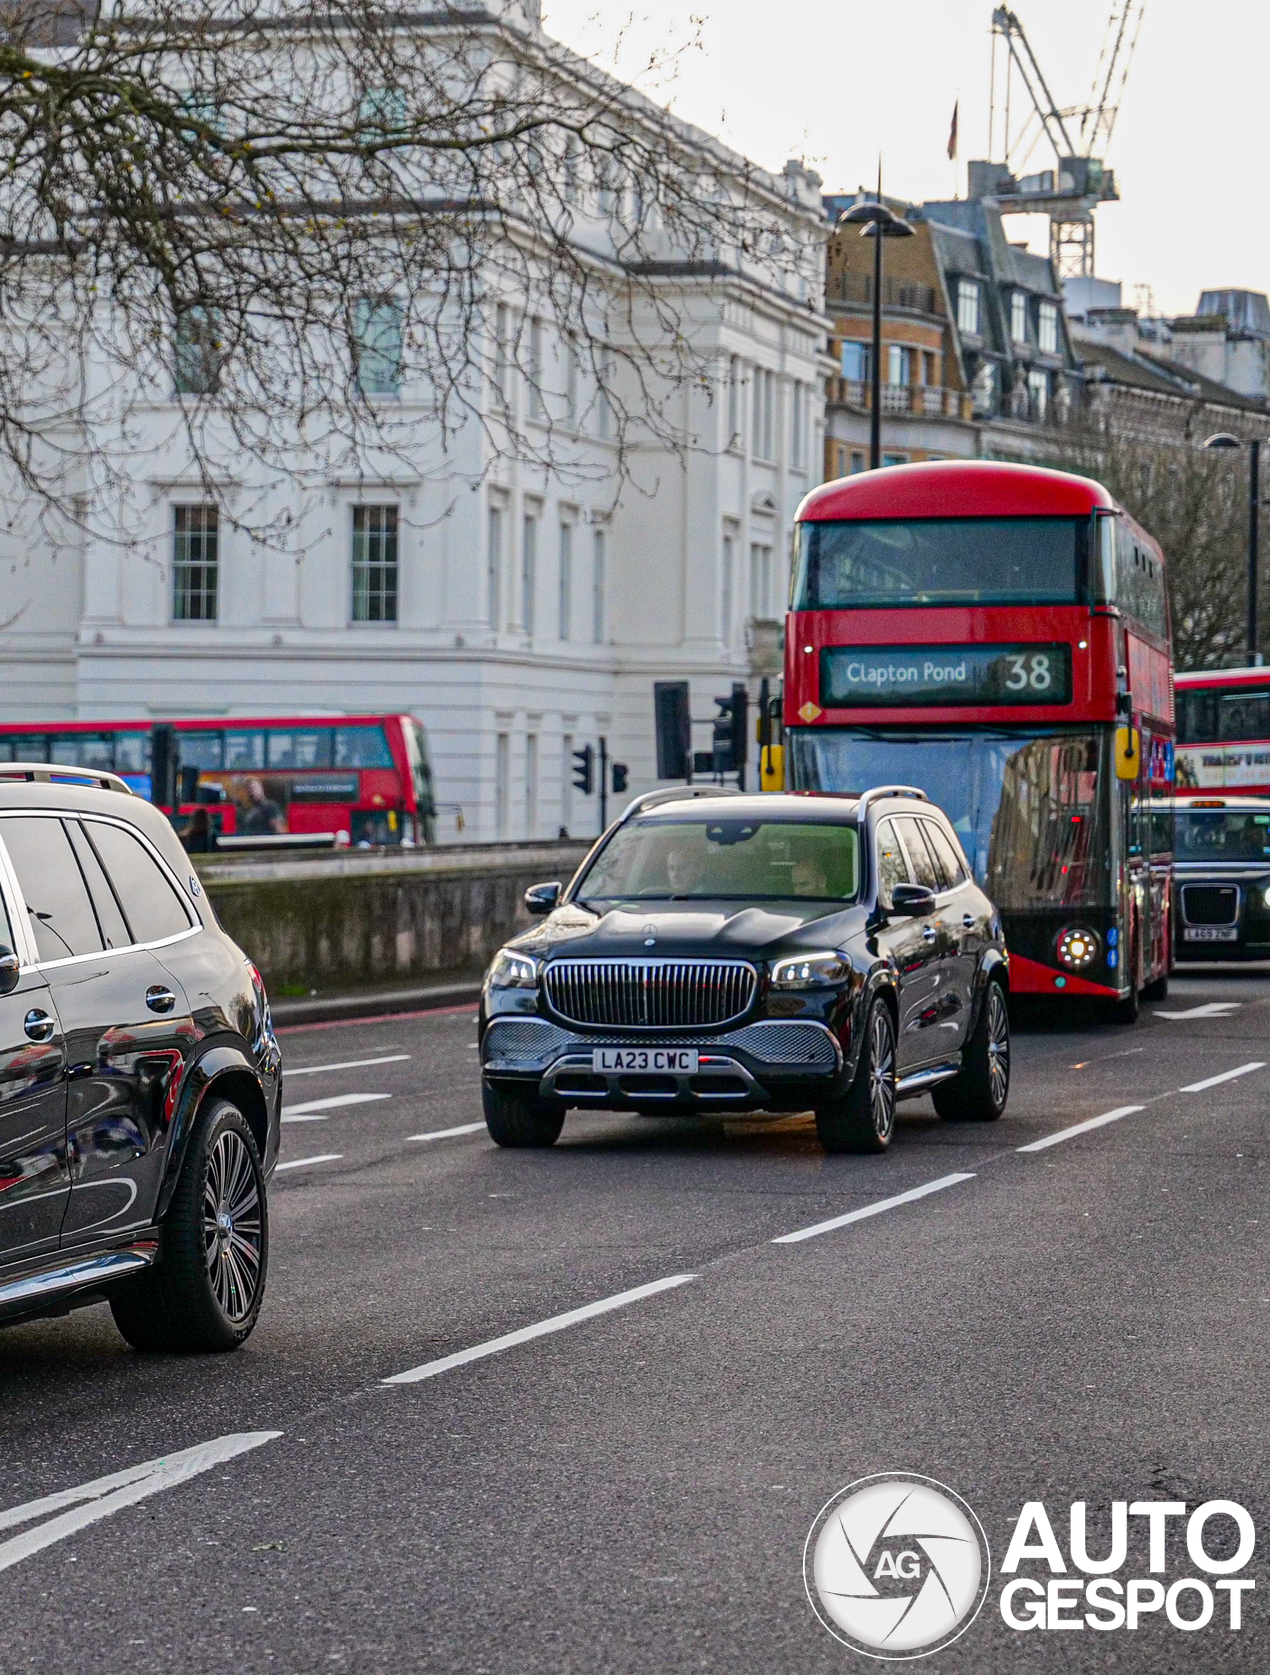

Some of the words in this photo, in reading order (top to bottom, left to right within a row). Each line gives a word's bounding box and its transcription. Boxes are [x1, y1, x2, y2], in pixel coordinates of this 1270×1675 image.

[847, 663, 917, 686] Clapton
[923, 662, 966, 681] Pond
[1005, 654, 1051, 690] 38
[602, 1052, 649, 1069] LA23
[654, 1052, 690, 1069] CWC
